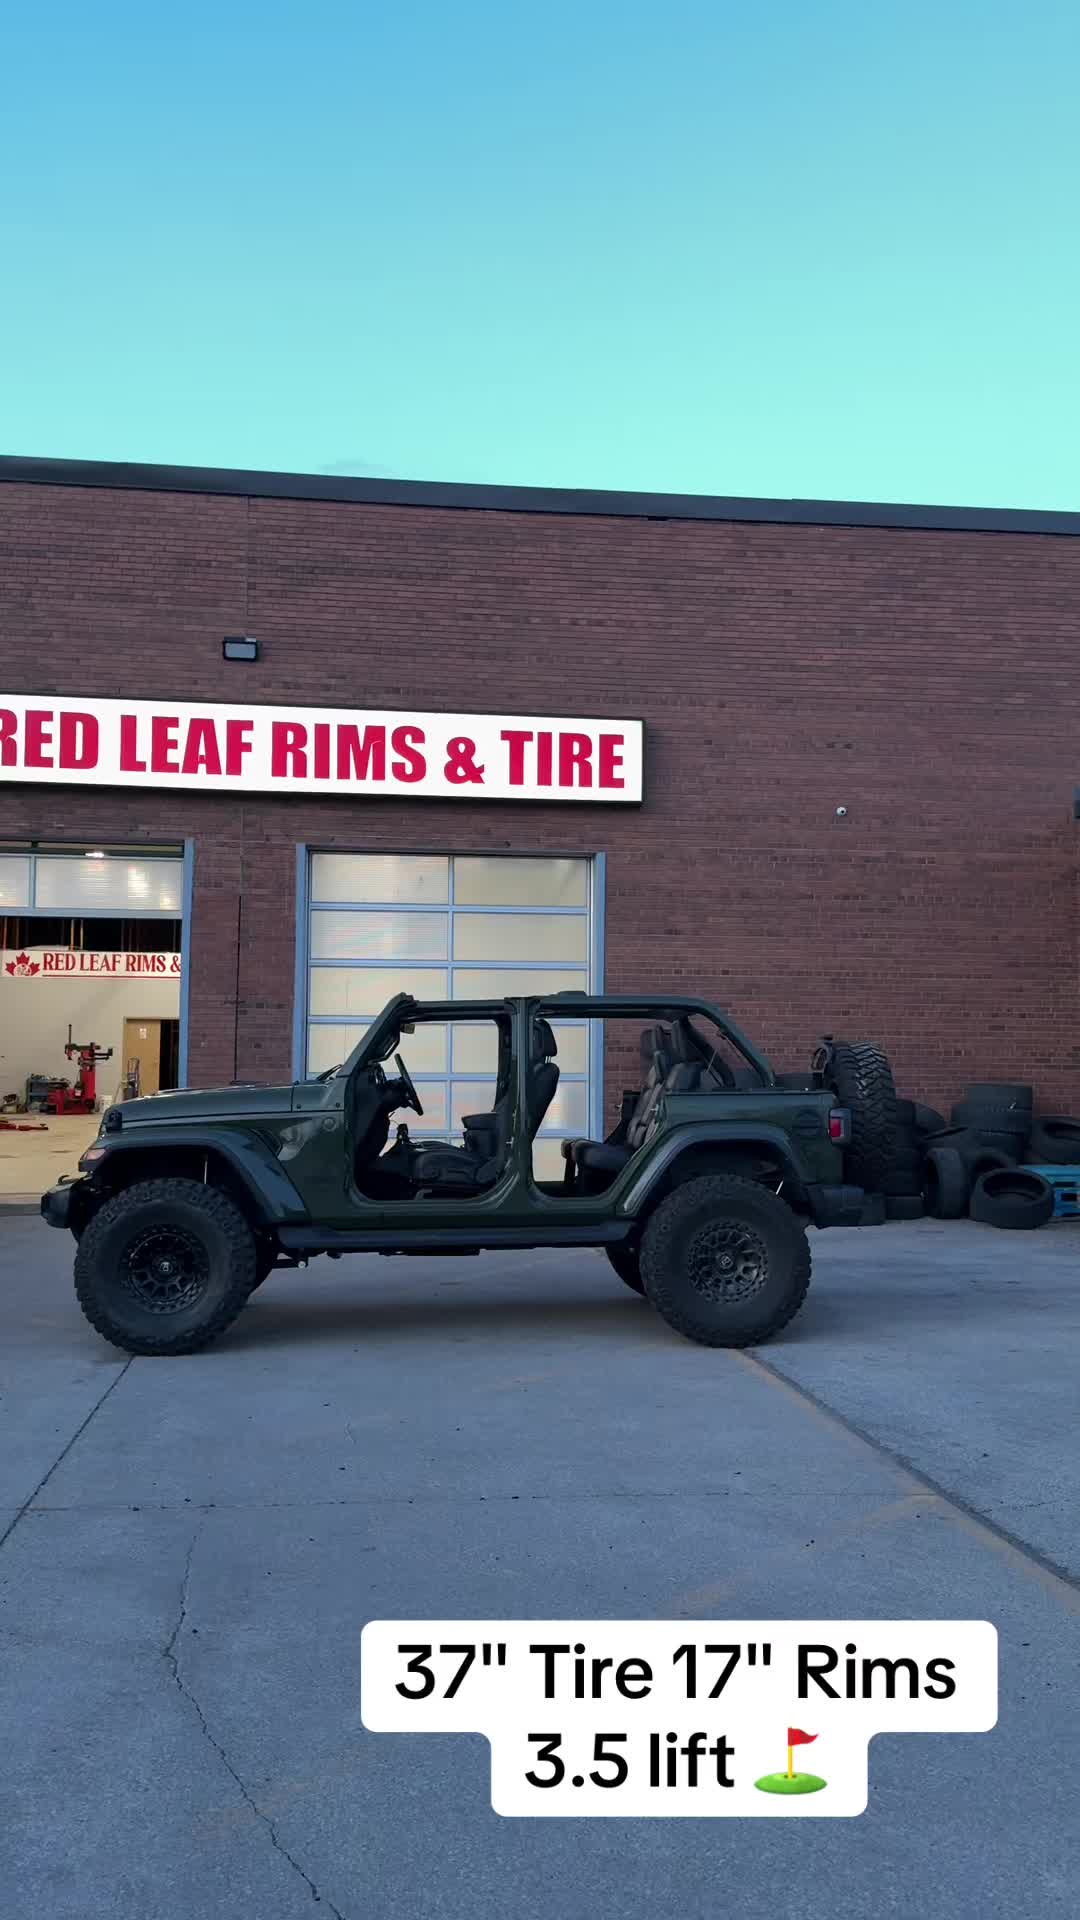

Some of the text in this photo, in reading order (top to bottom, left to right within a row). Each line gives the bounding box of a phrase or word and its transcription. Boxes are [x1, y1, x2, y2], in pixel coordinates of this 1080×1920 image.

[120, 714, 254, 776] LEAF
[271, 721, 427, 784] RIMS
[444, 736, 485, 785] &
[501, 730, 625, 789] TIRE
[43, 952, 76, 971] RED
[80, 953, 121, 972] LEAF
[125, 954, 166, 973] RIMS
[170, 955, 181, 973] &
